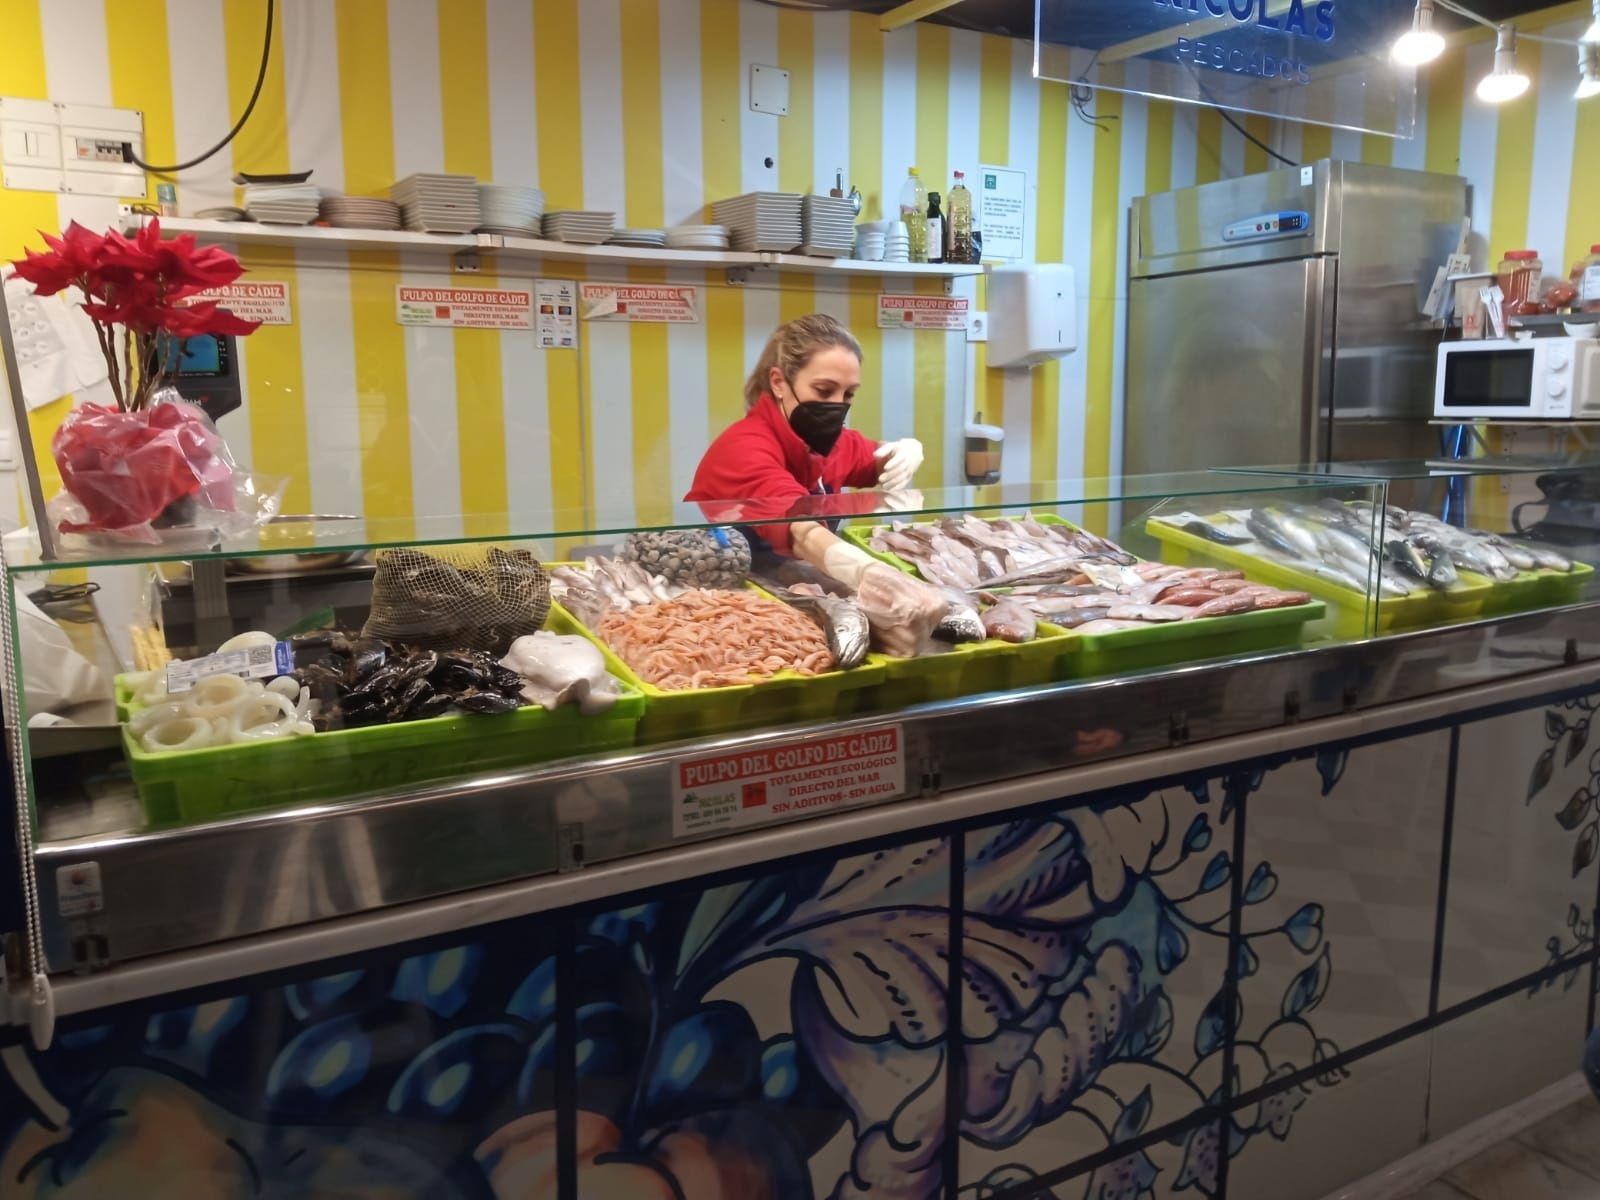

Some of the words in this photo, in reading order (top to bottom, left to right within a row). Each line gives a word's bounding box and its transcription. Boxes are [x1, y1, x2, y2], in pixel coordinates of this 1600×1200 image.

[1150, 0, 1336, 41] OLAS
[1177, 37, 1312, 85] PESCADOS
[201, 285, 229, 297] OLFO
[232, 286, 246, 297] DE
[402, 289, 434, 301] PULPO
[435, 291, 453, 302] DEL
[454, 292, 485, 303] GOLFO
[486, 293, 498, 304] DE
[499, 292, 527, 305] CÁDIZ
[631, 289, 657, 300] GOLFO
[686, 759, 739, 786] PULPO
[741, 754, 771, 776] DEL
[774, 744, 825, 769] GOLFO
[826, 741, 847, 761] DE
[849, 733, 894, 756] CÁDIZ
[769, 767, 840, 787] TOTALMENTE
[841, 755, 897, 773] ECOLÓGICO
[772, 801, 790, 814] SIN
[791, 792, 842, 810] ADITIVOS
[849, 787, 867, 800] SIN
[868, 782, 897, 795] AGUA
[789, 782, 835, 797] DIRECTO
[836, 777, 856, 790] DEL
[858, 772, 881, 785] MAR
